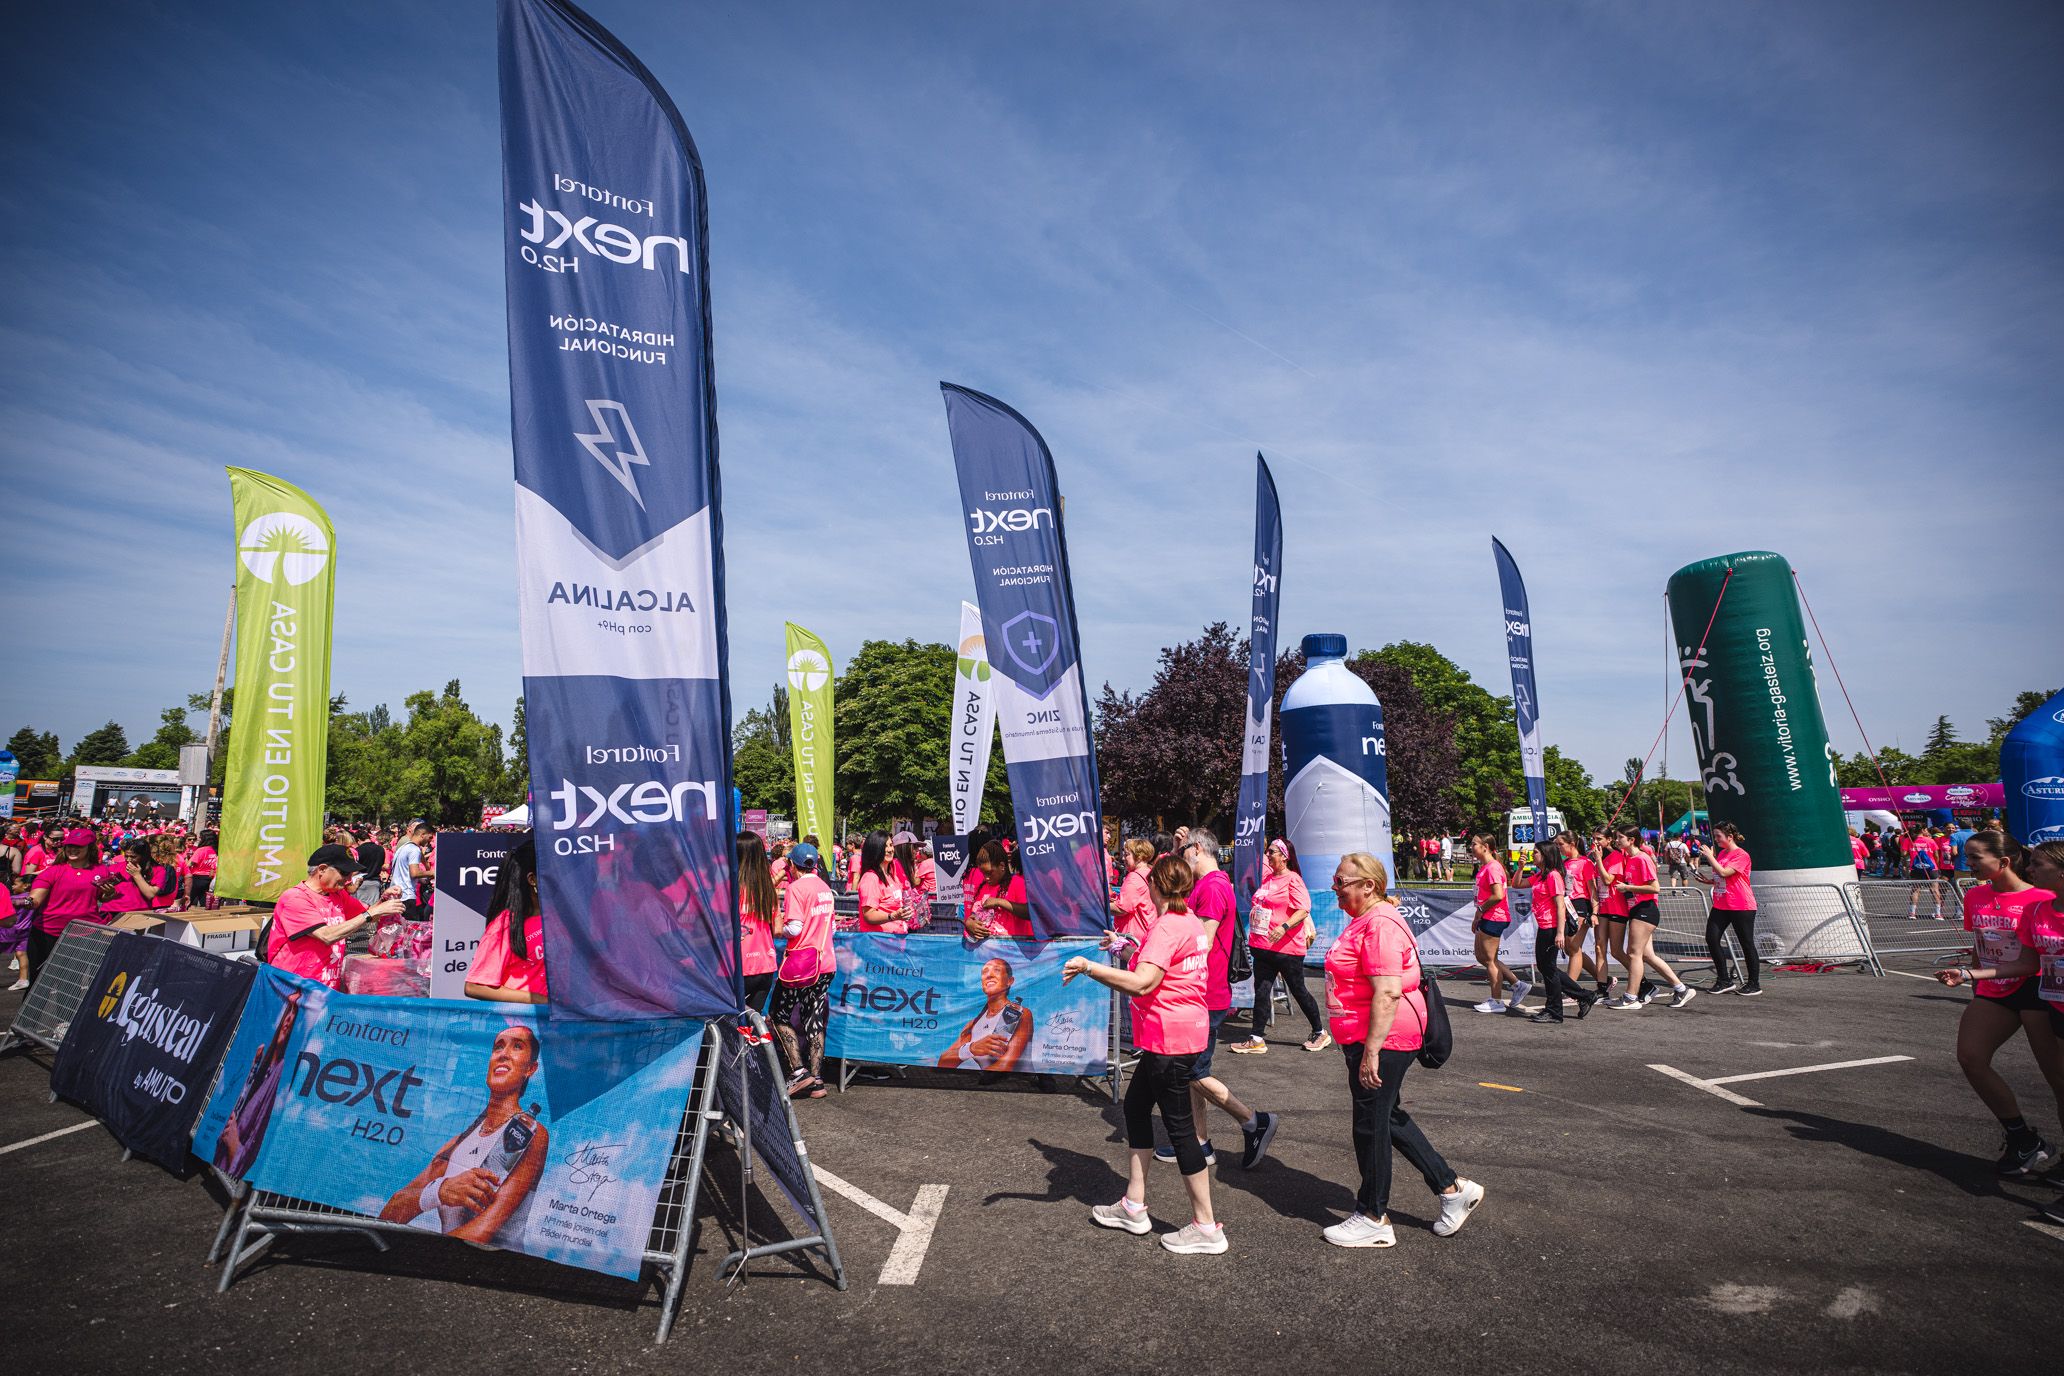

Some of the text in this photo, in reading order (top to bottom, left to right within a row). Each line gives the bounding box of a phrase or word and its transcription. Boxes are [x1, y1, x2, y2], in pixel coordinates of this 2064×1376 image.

[1756, 627, 1803, 792] www.vitoria-gasteiz.org
[1361, 736, 1386, 756] ne
[939, 848, 961, 862] next
[459, 866, 499, 886] ne
[1396, 904, 1430, 918] ext
[1971, 914, 2018, 931] CARRERA
[206, 932, 232, 940] FRAGILE
[445, 939, 465, 952] La
[1427, 948, 1440, 956] de
[1442, 948, 1451, 956] la
[444, 959, 468, 973] de
[865, 961, 925, 979] Fontarel
[840, 982, 942, 1016] next
[325, 1015, 410, 1047] Fontarel
[902, 1016, 939, 1030] H2.0
[289, 1050, 424, 1119] next
[350, 1117, 405, 1146] H2.0
[549, 1198, 618, 1225] Marta Ortega
